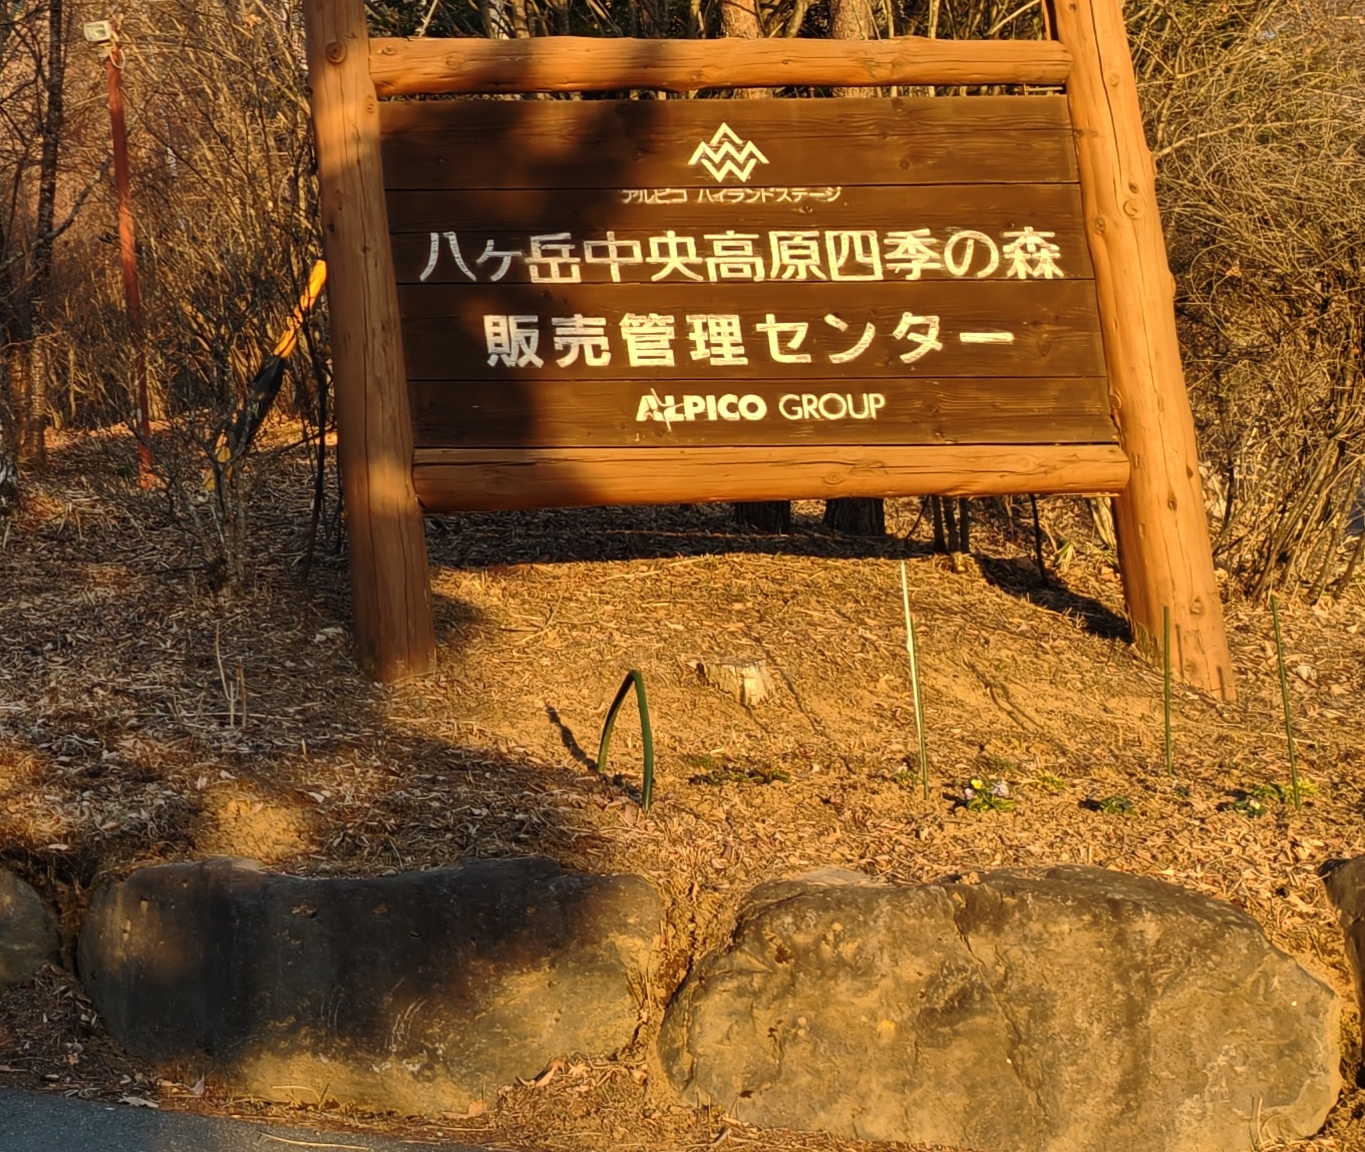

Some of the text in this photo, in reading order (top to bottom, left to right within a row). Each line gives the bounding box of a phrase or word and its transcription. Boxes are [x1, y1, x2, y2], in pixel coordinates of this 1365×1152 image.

[622, 186, 842, 204] アルピコ ハイランドステージ
[483, 311, 1015, 367] 販売管理センター
[635, 389, 886, 430] ALPICO GROUP
